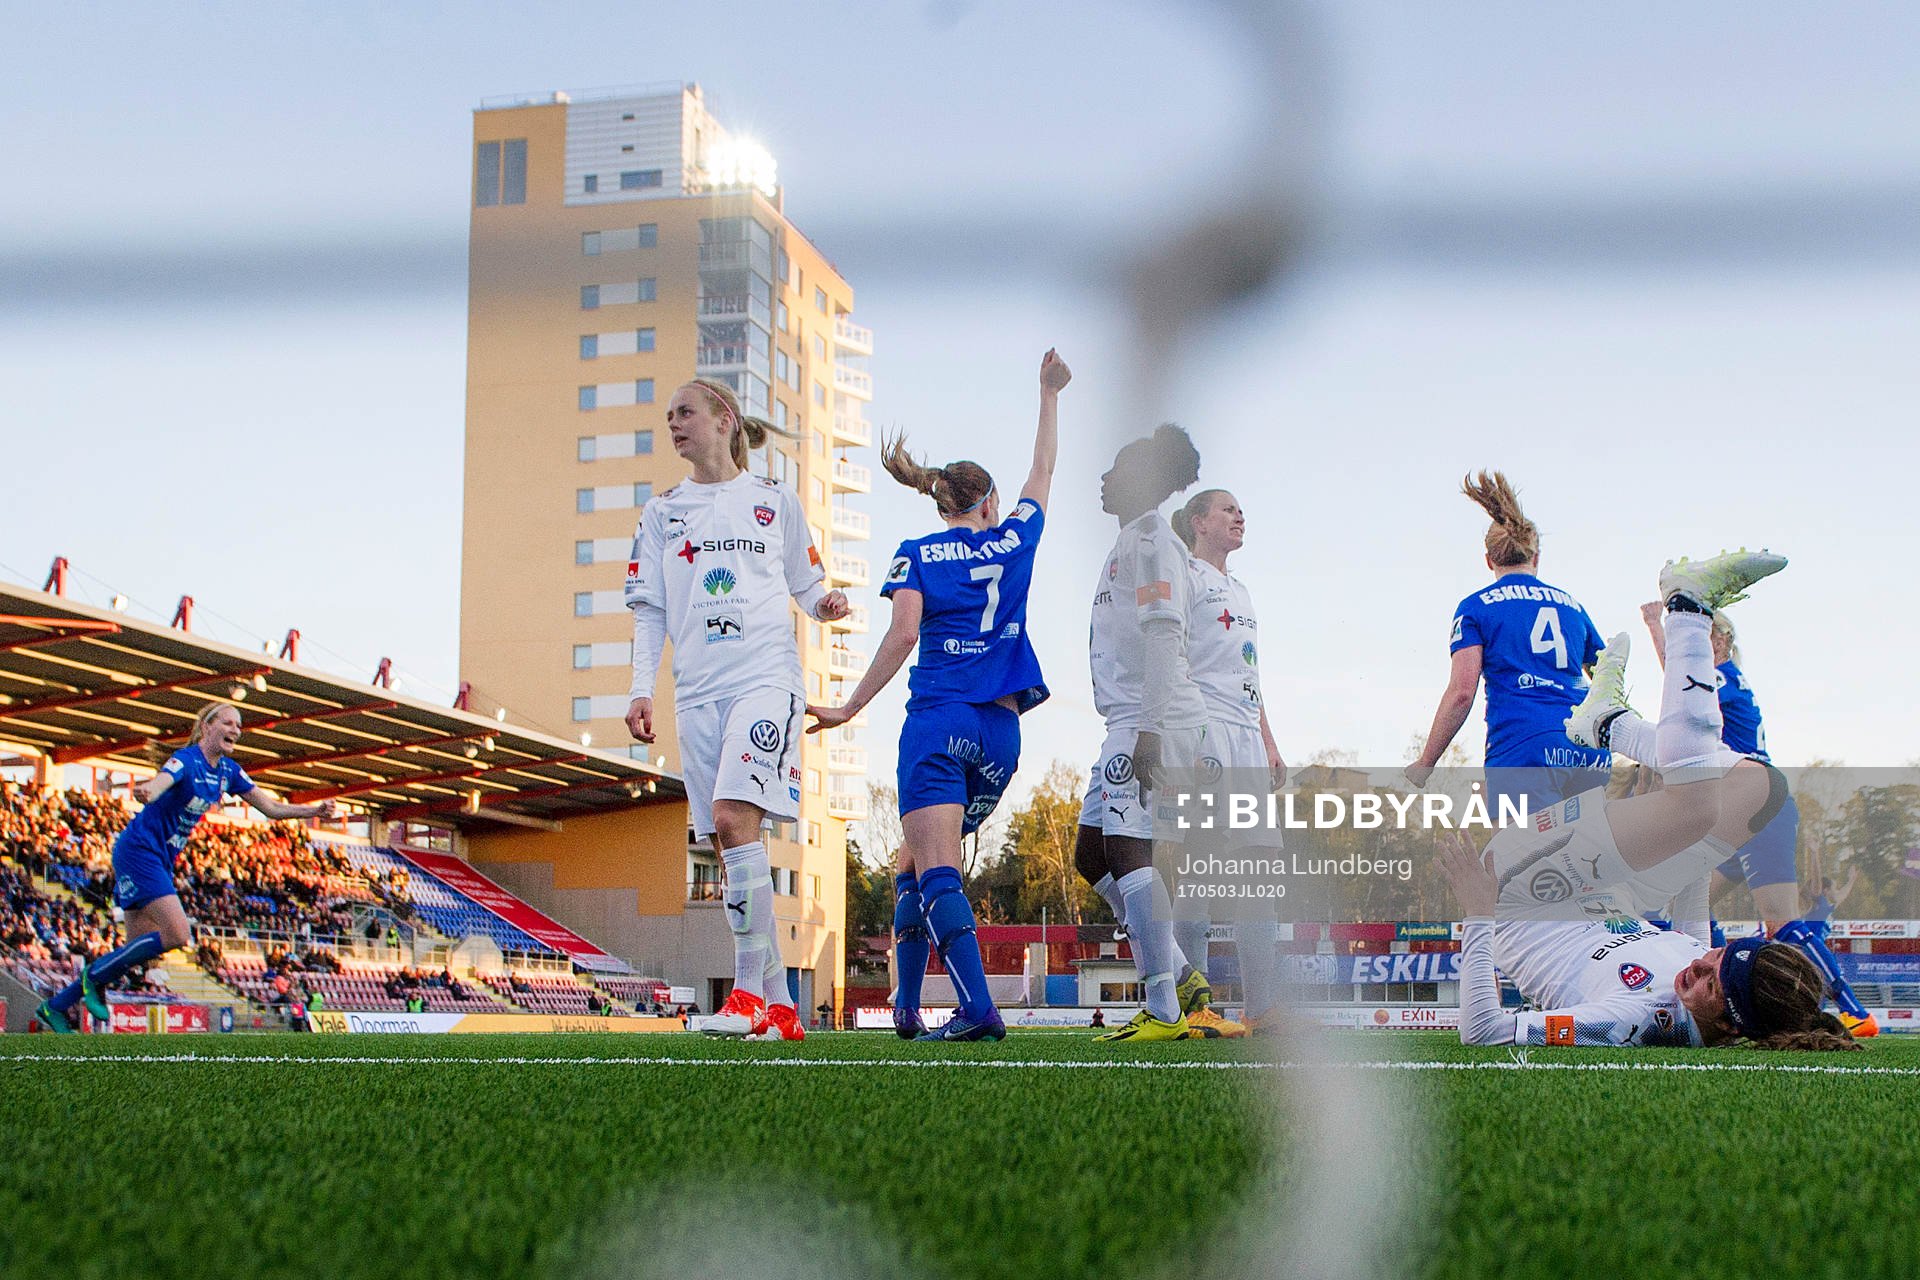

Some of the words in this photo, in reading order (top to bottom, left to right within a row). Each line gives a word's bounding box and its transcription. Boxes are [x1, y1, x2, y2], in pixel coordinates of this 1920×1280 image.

[969, 564, 1004, 633] 7
[1530, 607, 1568, 669] 4
[1544, 747, 1587, 769] MOCCA
[1400, 926, 1448, 936] Assemblin
[1351, 953, 1462, 983] ESKILS
[1626, 969, 1646, 985] FCR
[313, 1014, 346, 1033] Yale
[351, 1015, 422, 1034] Doorman
[1017, 1015, 1092, 1026] Eskilstuna-Kurire
[1401, 1008, 1436, 1022] EXIN
